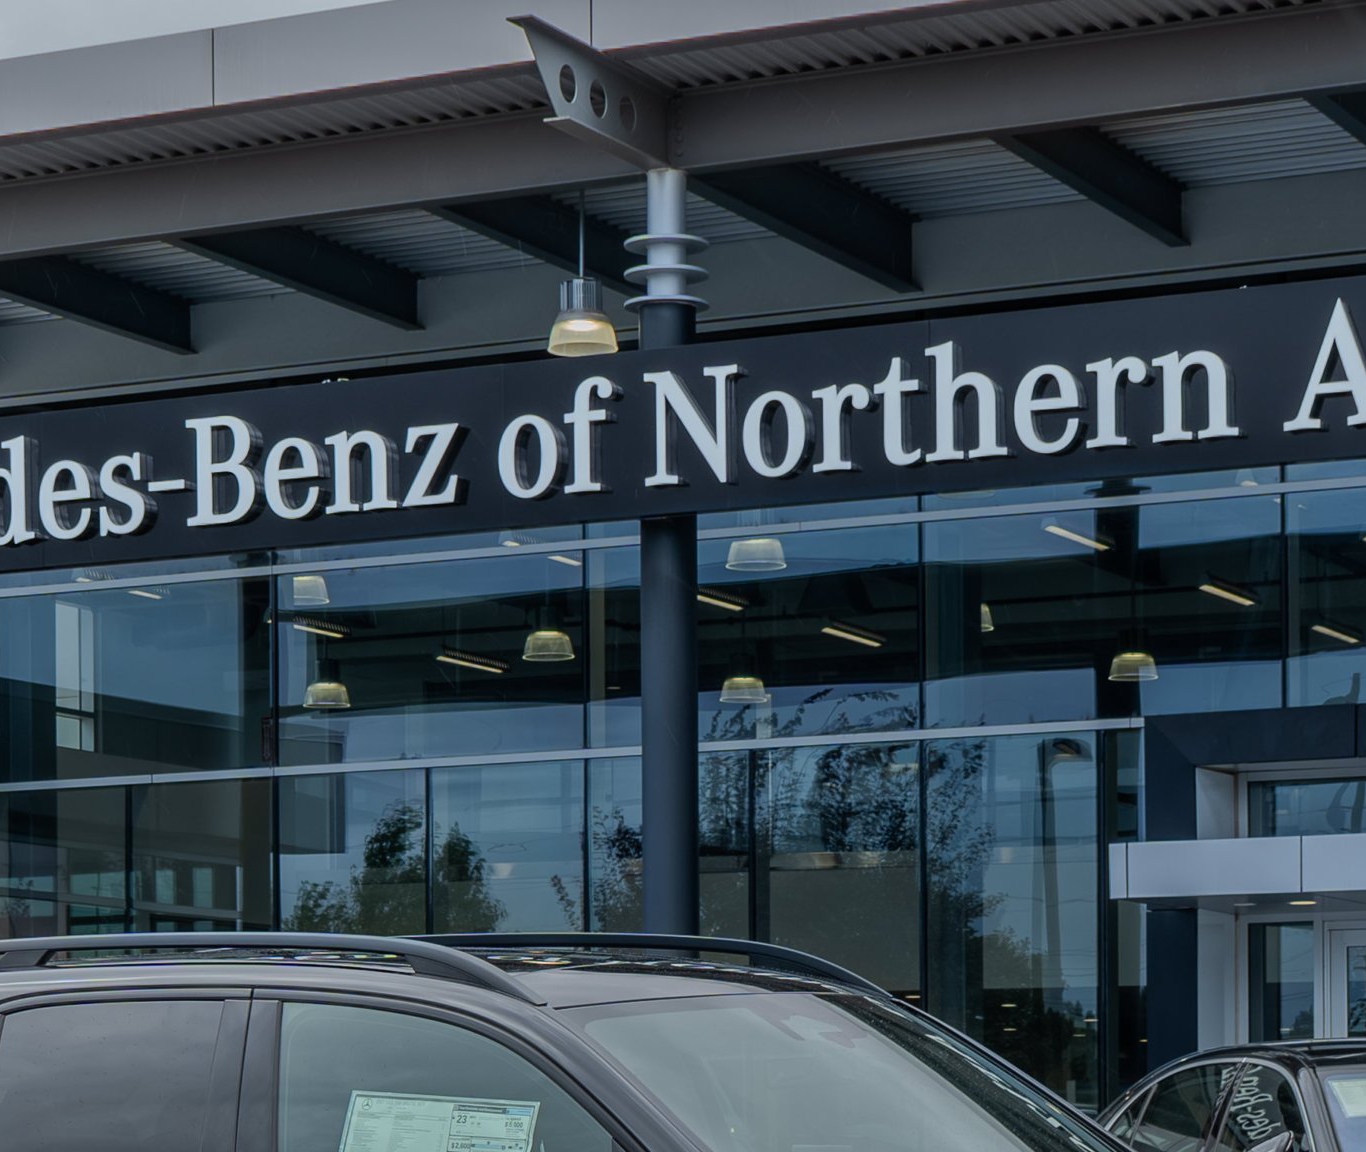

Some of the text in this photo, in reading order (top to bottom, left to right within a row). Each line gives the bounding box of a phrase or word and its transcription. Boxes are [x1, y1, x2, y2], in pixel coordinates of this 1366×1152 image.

[497, 376, 616, 500] of
[643, 341, 1239, 487] Northern
[456, 1115, 467, 1124] 23
